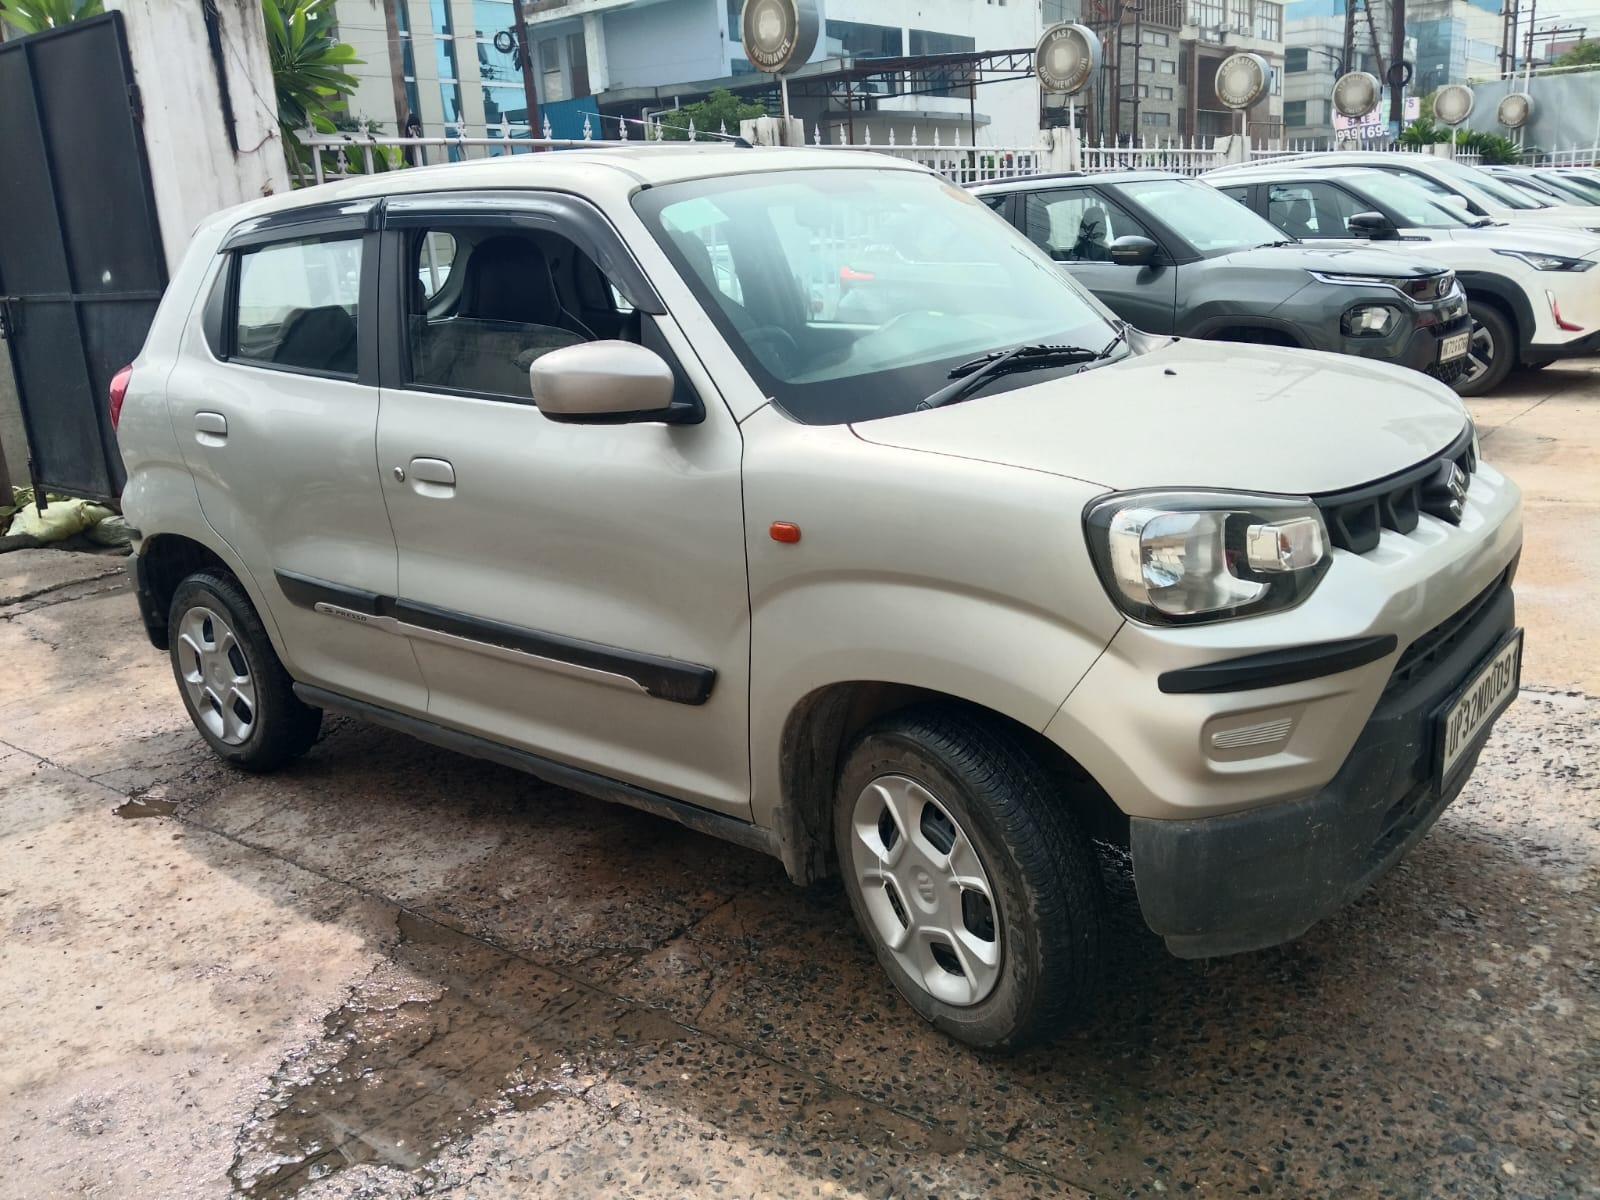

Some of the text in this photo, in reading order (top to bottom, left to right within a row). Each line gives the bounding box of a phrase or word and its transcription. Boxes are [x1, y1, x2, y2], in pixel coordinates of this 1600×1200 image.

[1051, 29, 1072, 41] EASY
[751, 38, 791, 65] INSURANCE
[1039, 57, 1089, 88] DOCUMENTATION
[1449, 647, 1519, 757] UP32ND0091
